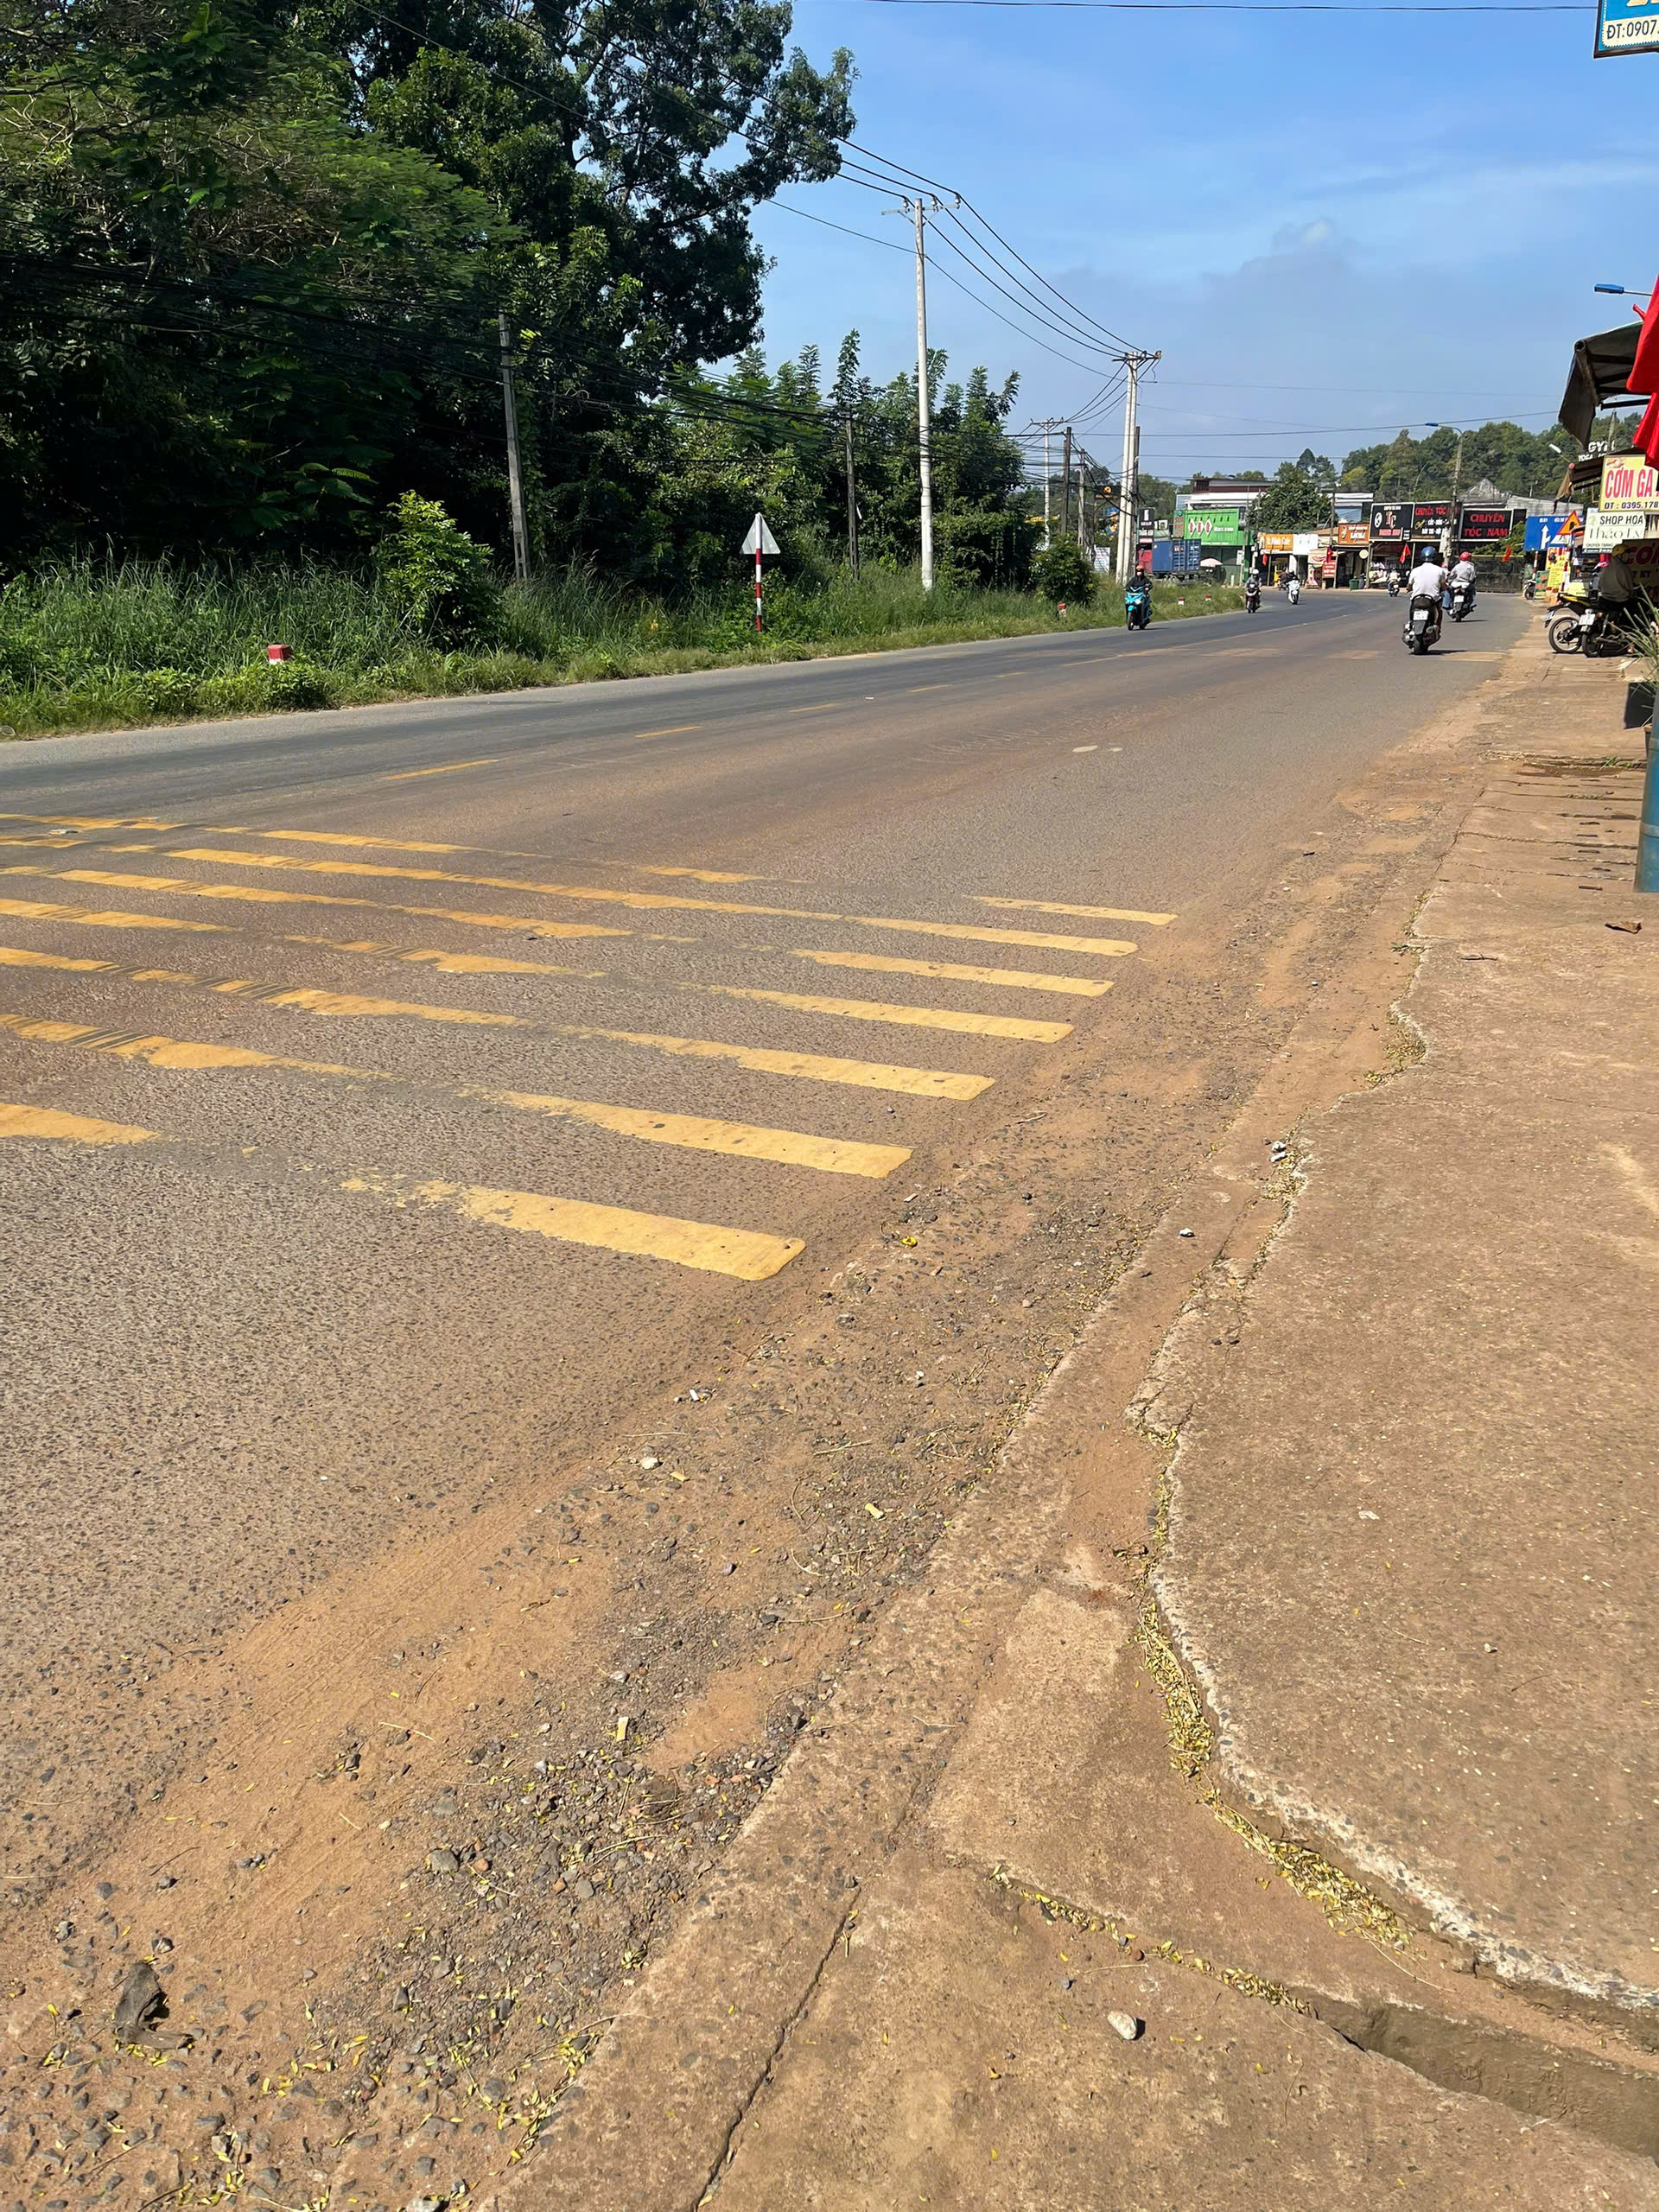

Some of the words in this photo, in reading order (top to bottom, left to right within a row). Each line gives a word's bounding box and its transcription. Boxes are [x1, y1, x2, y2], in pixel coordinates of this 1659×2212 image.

[1605, 467, 1634, 499] CƠM
[1470, 512, 1505, 523] CHUYÊN
[1599, 515, 1624, 525] SHOP
[1625, 515, 1643, 524] HOA
[1463, 526, 1483, 537] TÓC
[1486, 528, 1508, 537] NAM
